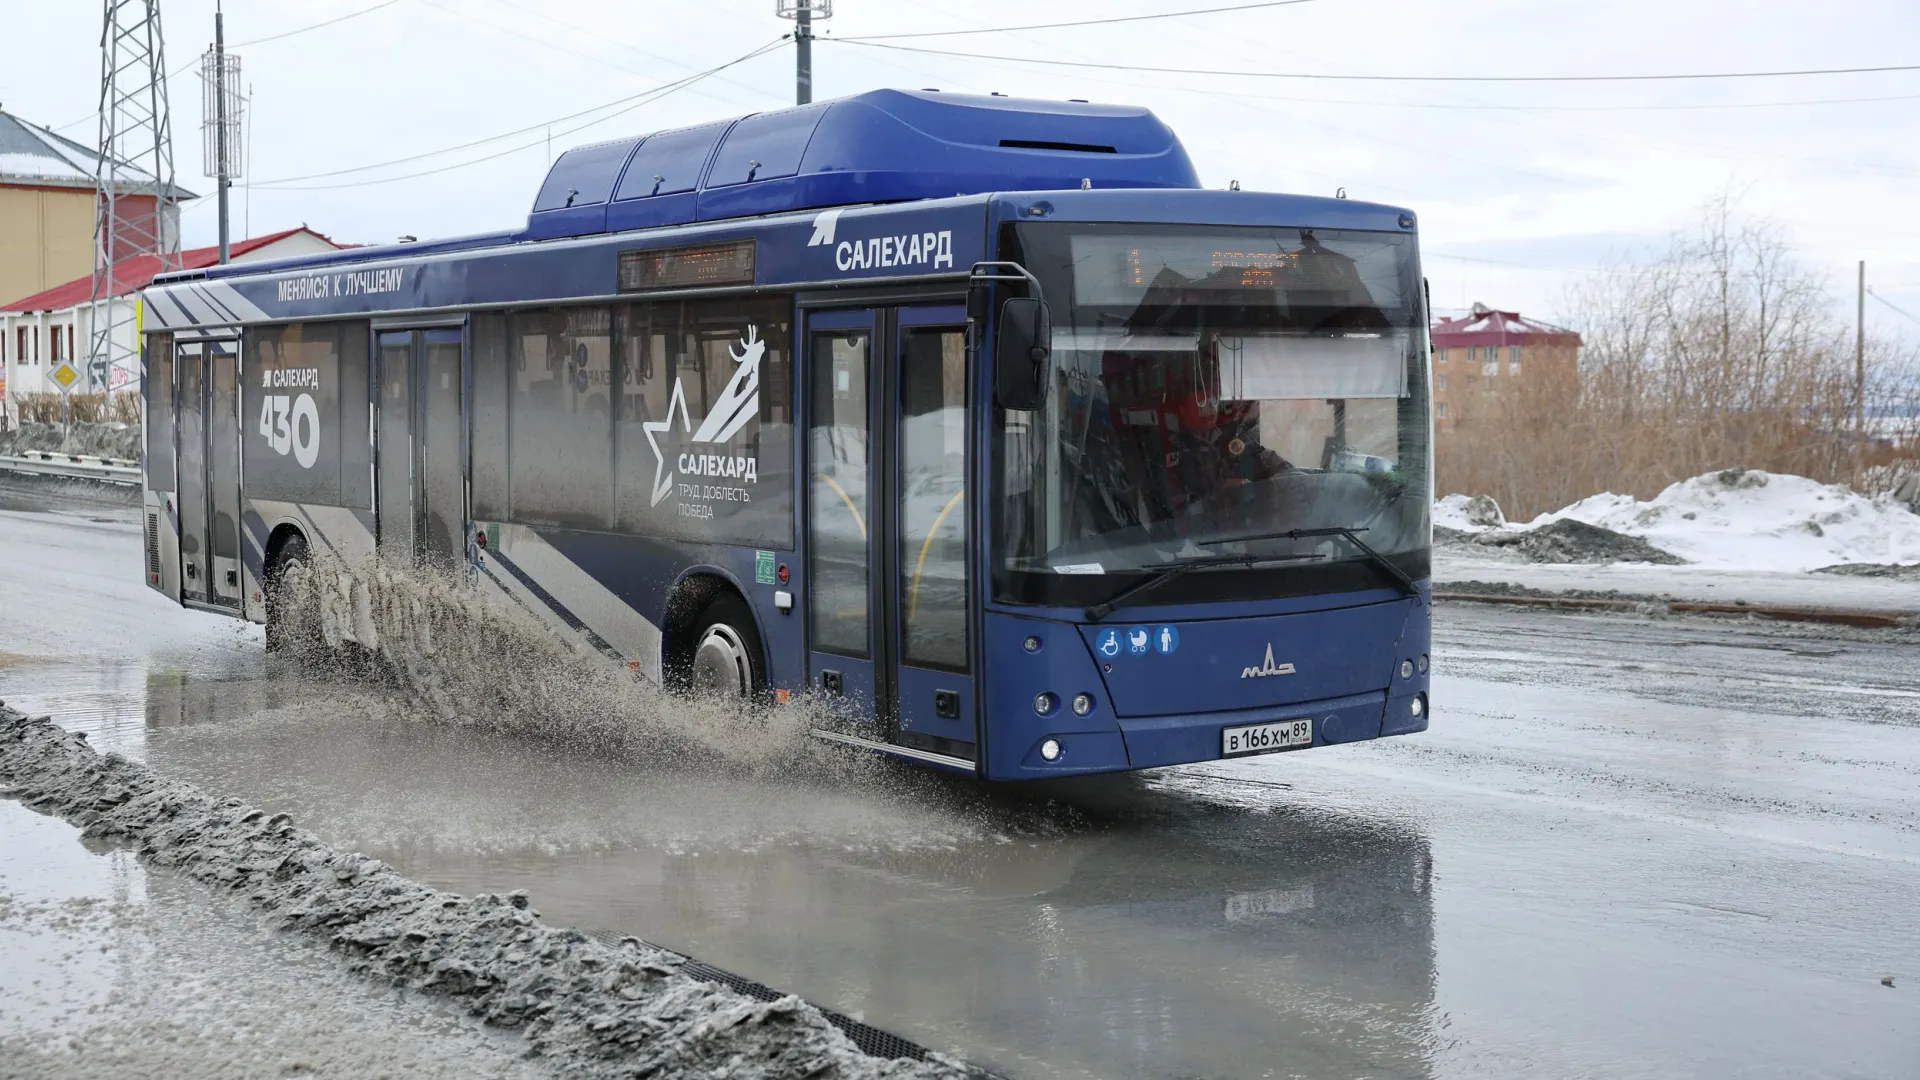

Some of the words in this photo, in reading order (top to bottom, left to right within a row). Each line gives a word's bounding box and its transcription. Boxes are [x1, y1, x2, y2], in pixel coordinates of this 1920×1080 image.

[835, 230, 953, 271] САЛЕХАРД
[278, 272, 329, 302] МЕНЯЙСЯ
[334, 274, 341, 297] К
[345, 268, 403, 295] ЛУЧШЕМУ
[273, 368, 319, 390] САЛЕХАРД
[259, 392, 320, 469] 430
[678, 453, 757, 483] САЛЕХАРД
[678, 503, 714, 520] ПОБЕДА
[1293, 722, 1308, 737] 89
